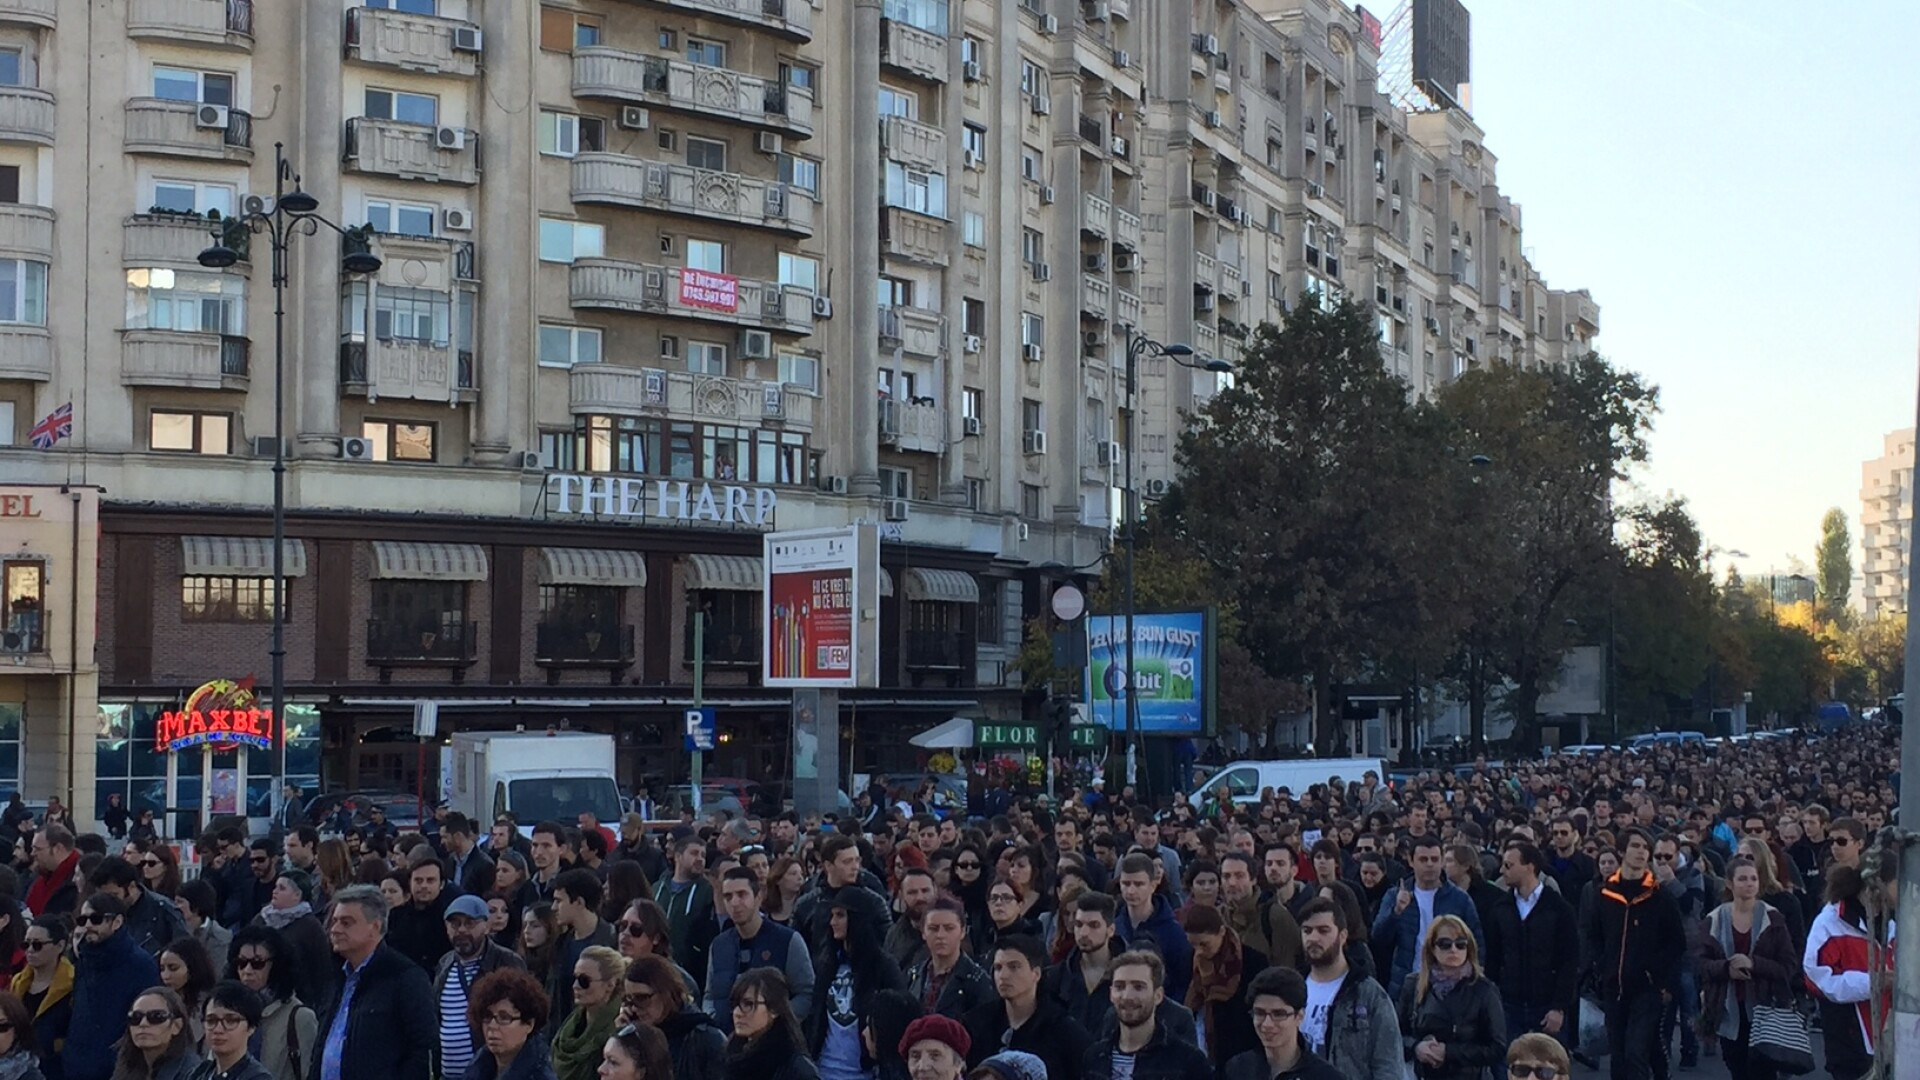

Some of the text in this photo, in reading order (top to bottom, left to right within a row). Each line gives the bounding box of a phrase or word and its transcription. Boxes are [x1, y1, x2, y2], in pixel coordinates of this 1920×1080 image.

[548, 474, 777, 525] THE HARP
[1136, 625, 1165, 642] BUN
[1166, 626, 1201, 648] GUST
[686, 711, 703, 735] P
